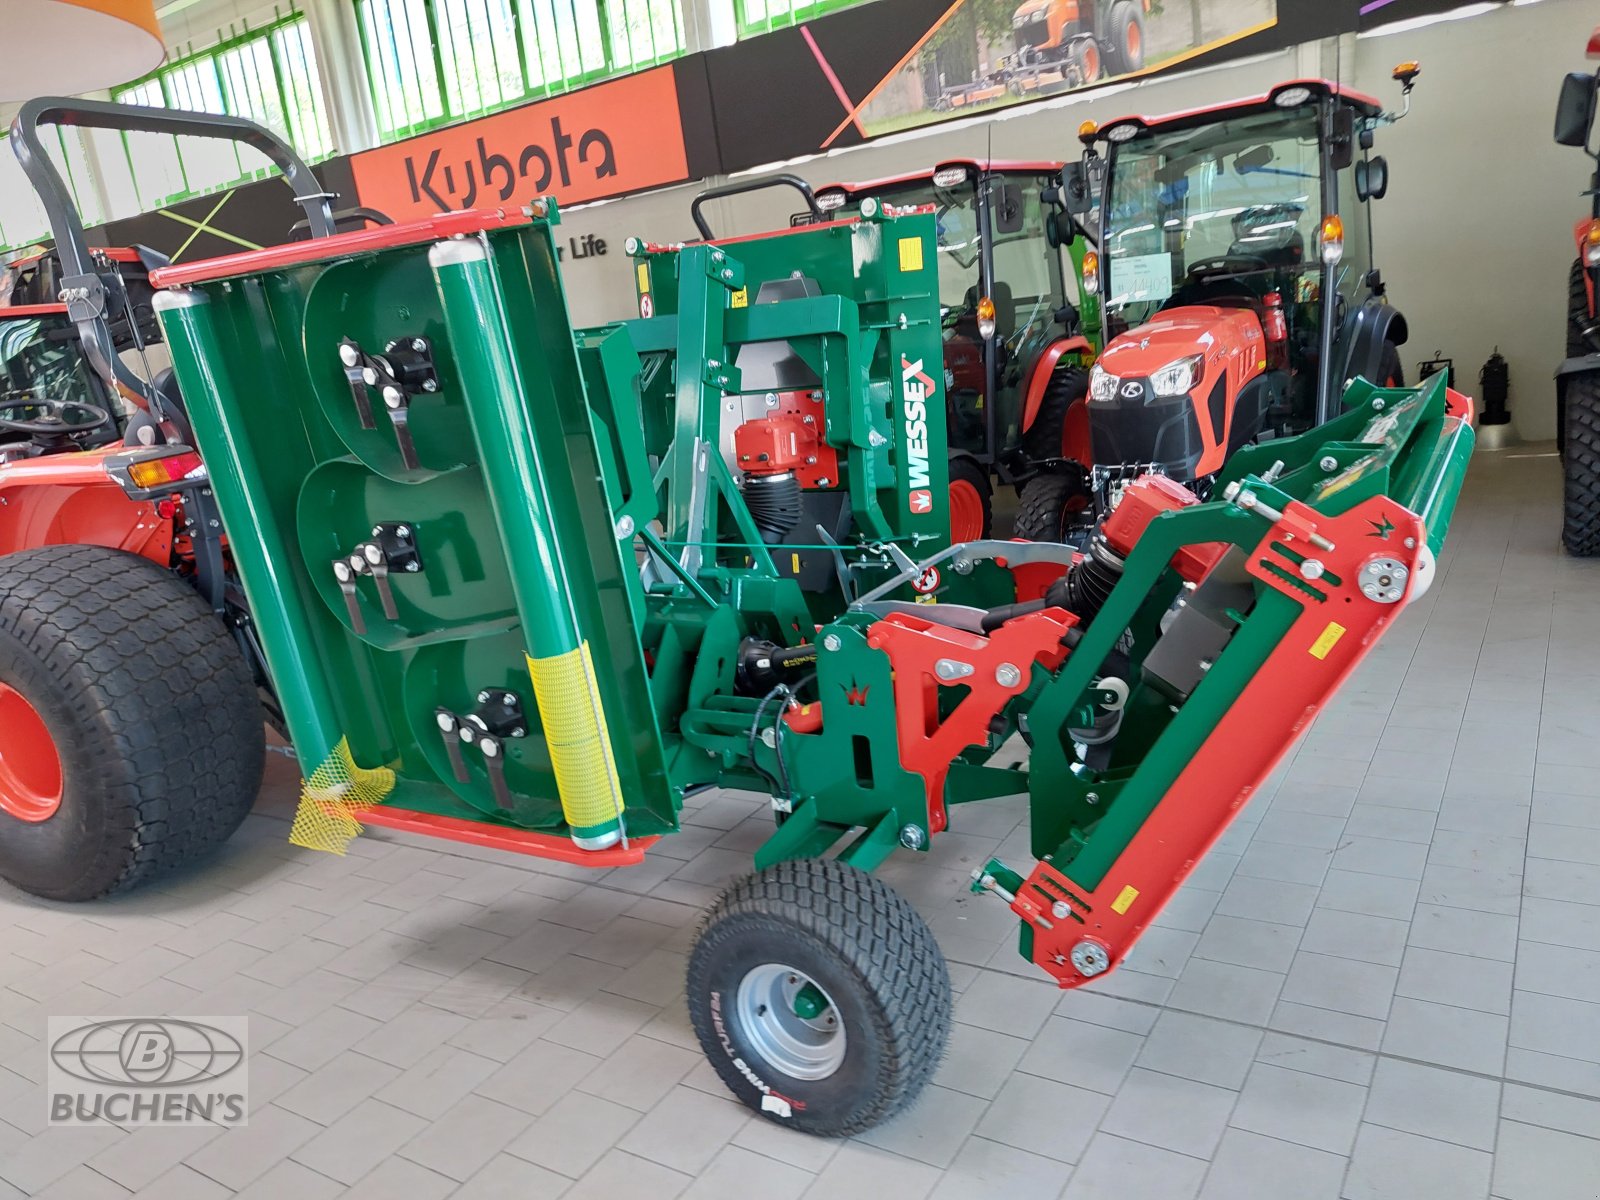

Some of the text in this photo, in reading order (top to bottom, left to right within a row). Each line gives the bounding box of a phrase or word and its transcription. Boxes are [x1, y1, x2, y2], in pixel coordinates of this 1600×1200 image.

[405, 116, 617, 213] Kubota
[569, 234, 607, 259] Life
[902, 357, 936, 488] WESSEX
